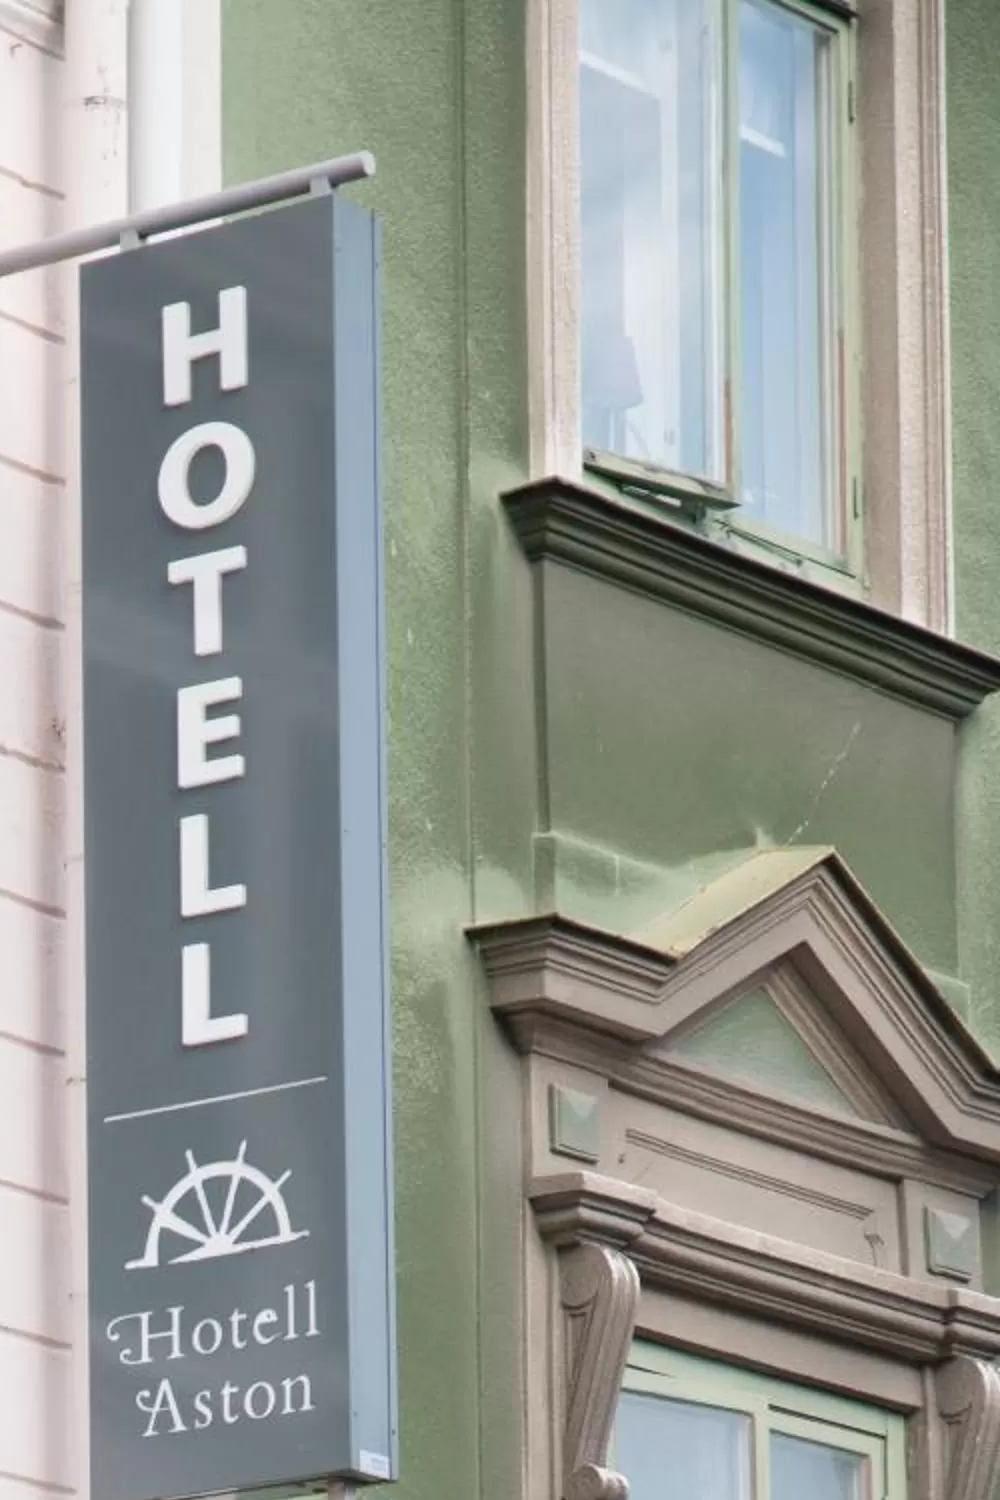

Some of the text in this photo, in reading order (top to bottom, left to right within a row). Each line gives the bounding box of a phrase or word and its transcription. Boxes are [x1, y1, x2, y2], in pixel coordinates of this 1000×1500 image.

[157, 284, 256, 1046] HOTELL
[105, 1279, 322, 1366] Hotell
[135, 1373, 316, 1438] Aston
